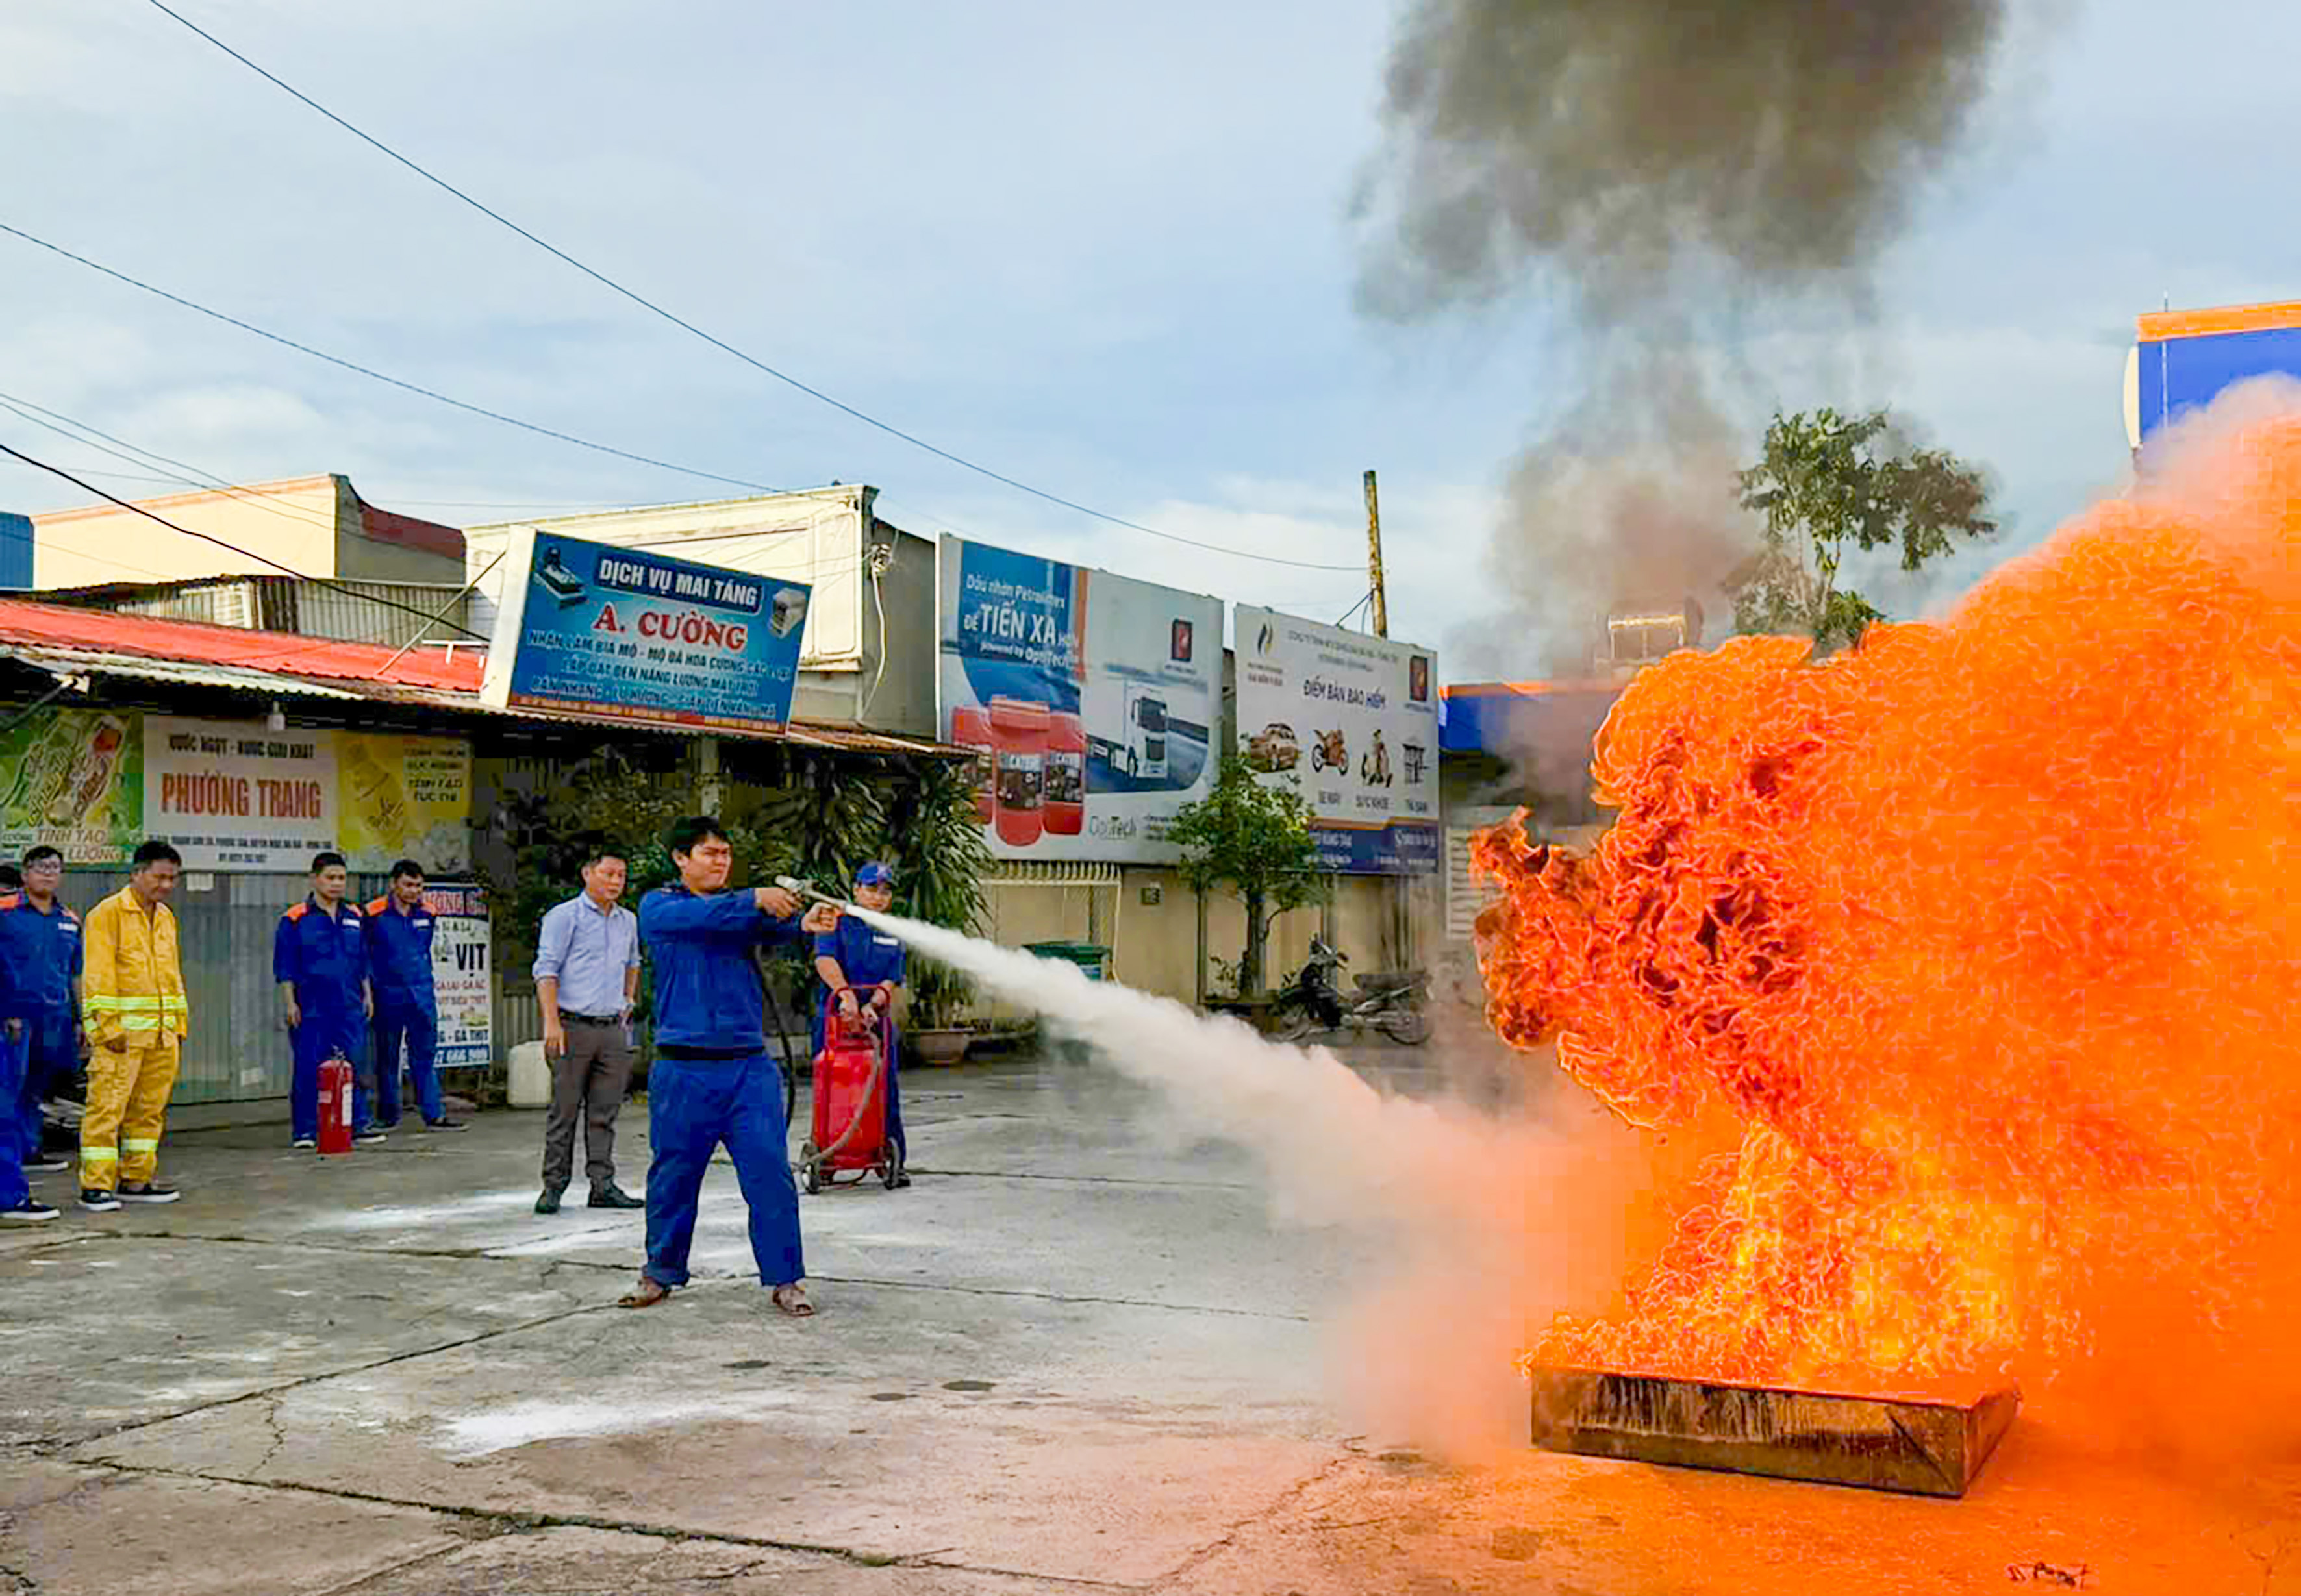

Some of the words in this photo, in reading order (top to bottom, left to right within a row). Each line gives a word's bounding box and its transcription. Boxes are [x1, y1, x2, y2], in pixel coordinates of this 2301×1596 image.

[599, 559, 644, 586] DỊCH
[649, 567, 672, 595] VỤ
[675, 573, 710, 598] MAI
[715, 579, 758, 606] TÁNG
[592, 601, 626, 632] A.
[638, 608, 746, 652] CƯỜNG
[980, 600, 1025, 640] TIẾN
[1029, 614, 1057, 646] XA
[162, 769, 249, 816] PHƯƠNG
[258, 778, 321, 818] TRANG
[456, 943, 486, 977] VỊT
